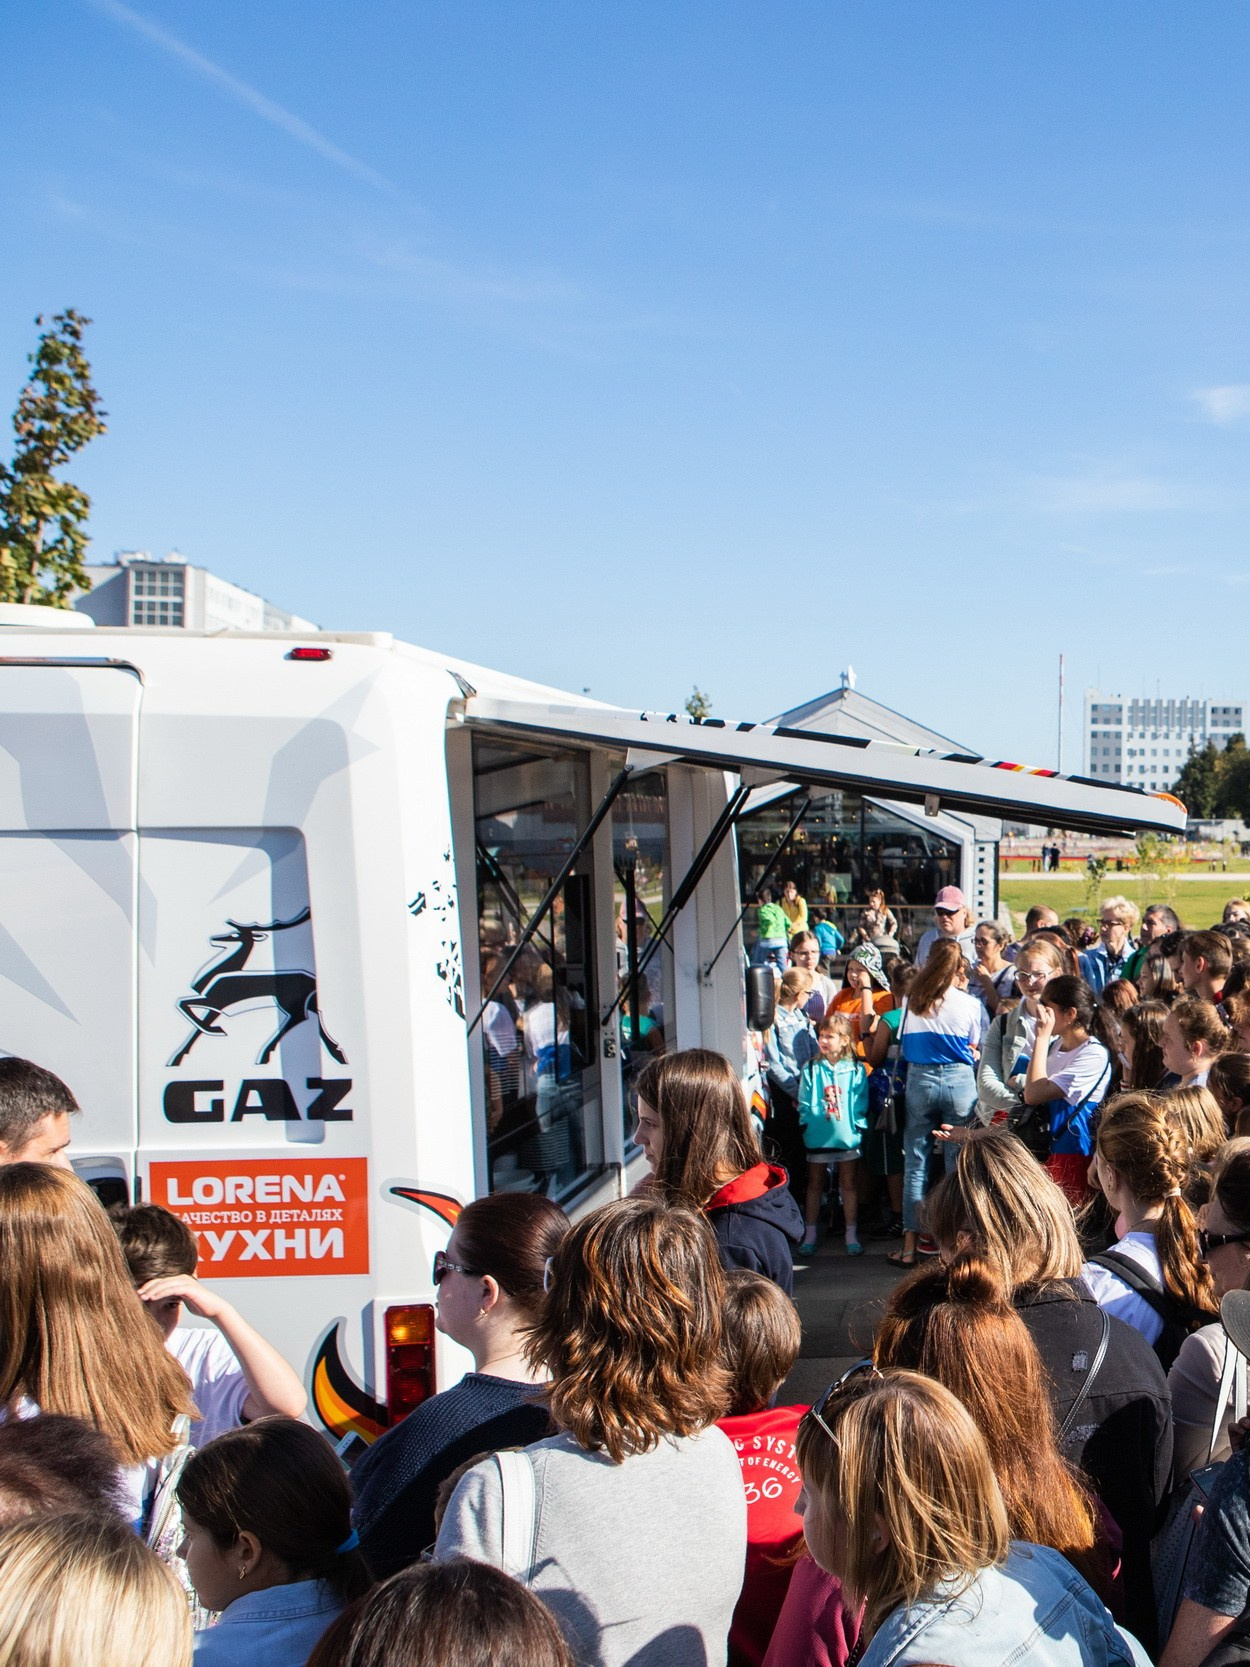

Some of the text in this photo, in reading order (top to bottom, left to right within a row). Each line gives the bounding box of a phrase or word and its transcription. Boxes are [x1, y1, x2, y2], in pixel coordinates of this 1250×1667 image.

[163, 1078, 353, 1123] GAZ
[166, 1174, 346, 1206] LORENA
[175, 1208, 344, 1225] АЧЕСТВО В ДЕТАЛЯХ
[752, 1435, 798, 1464] SYST
[747, 1456, 761, 1466] OF
[762, 1457, 801, 1484] ENERGY
